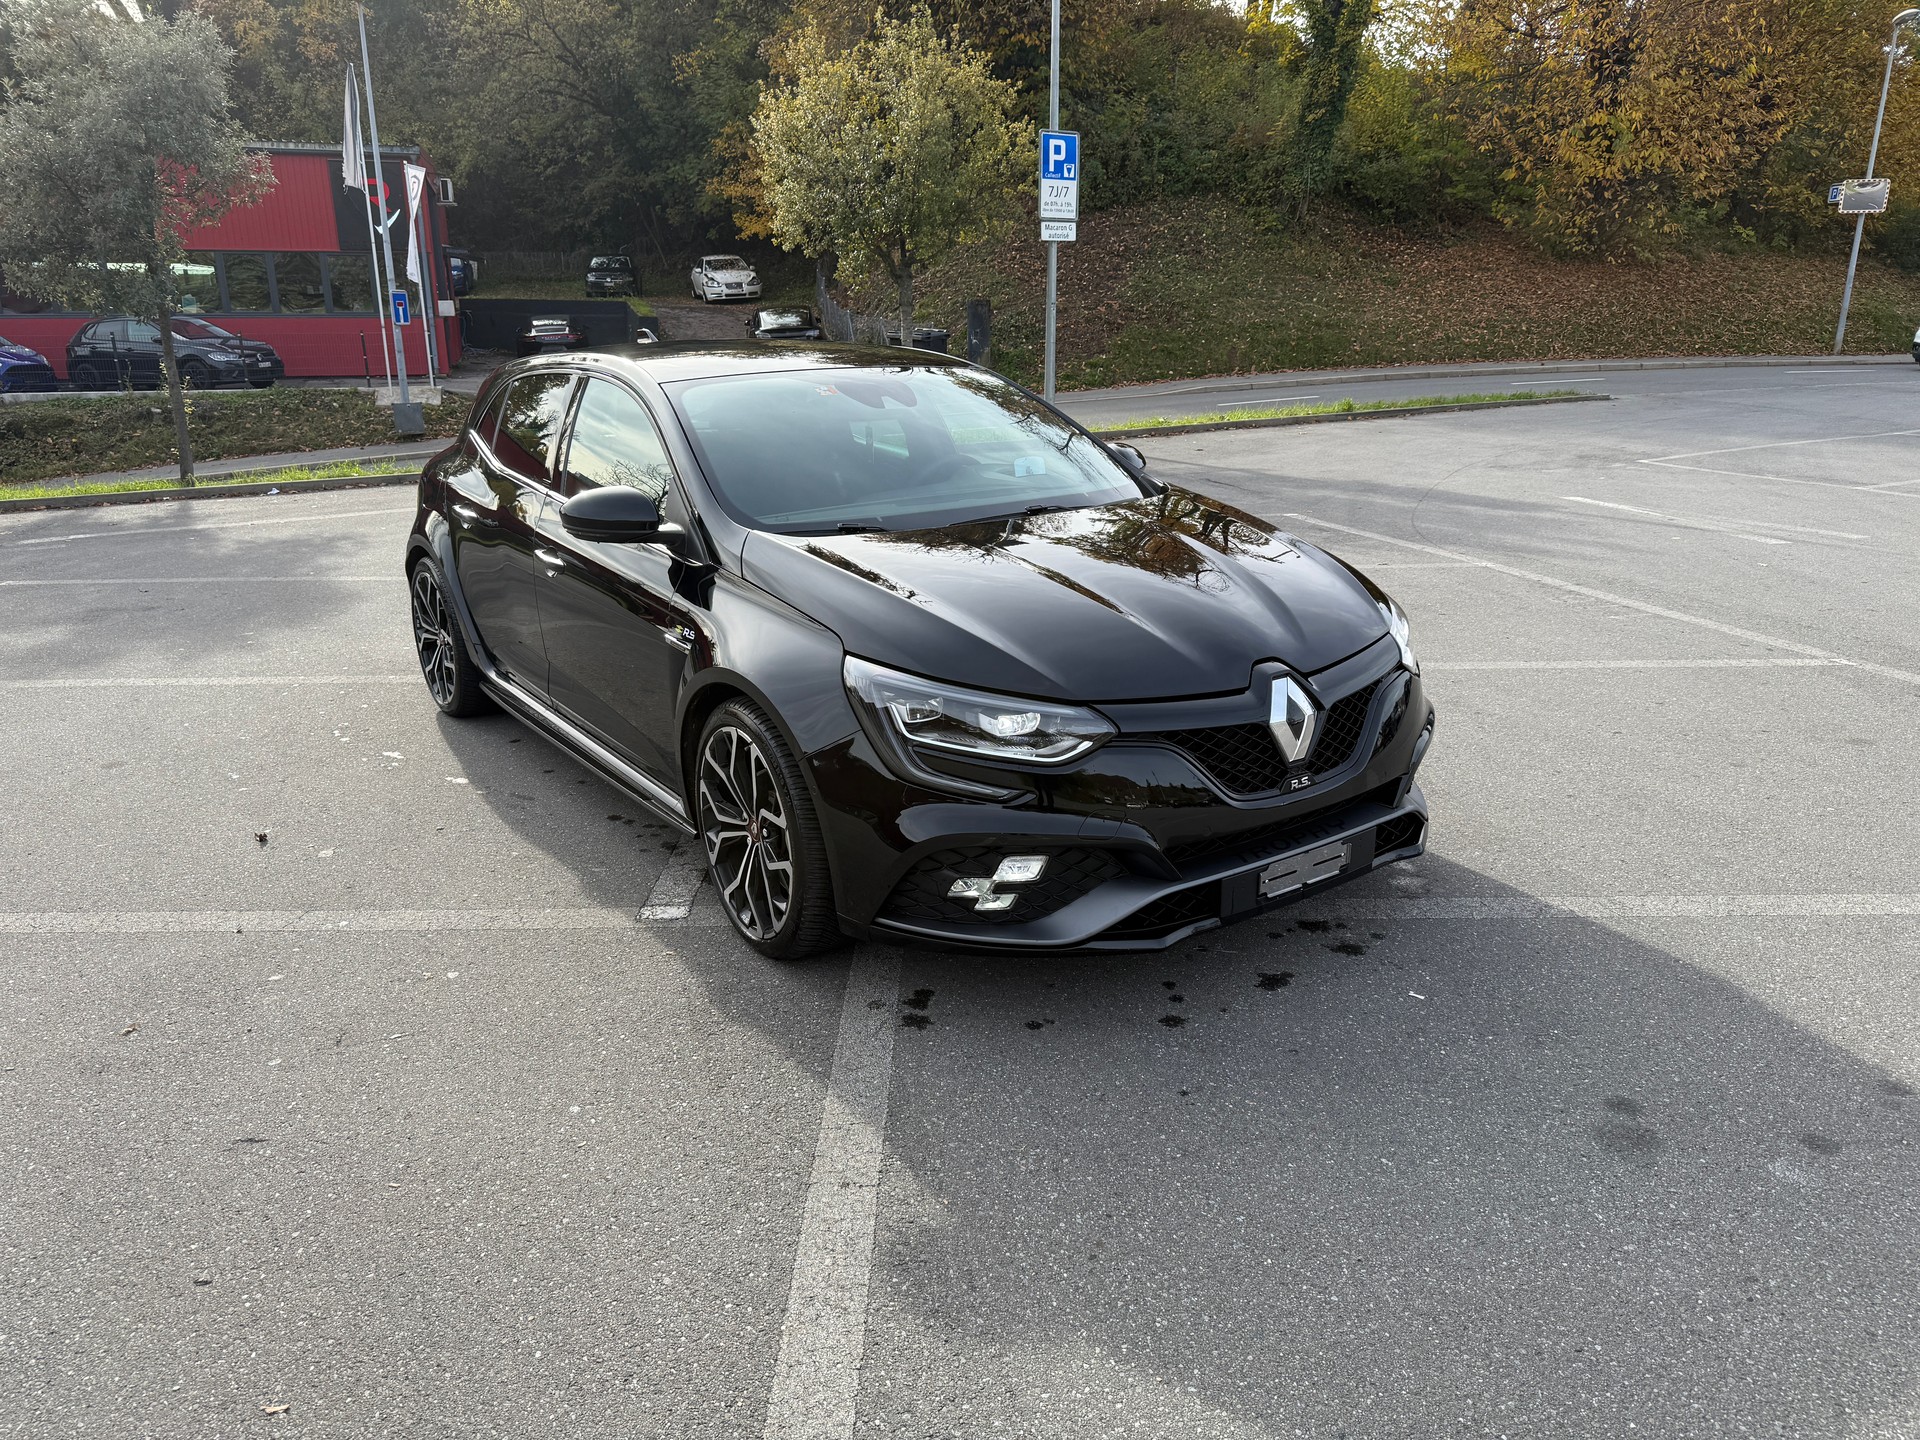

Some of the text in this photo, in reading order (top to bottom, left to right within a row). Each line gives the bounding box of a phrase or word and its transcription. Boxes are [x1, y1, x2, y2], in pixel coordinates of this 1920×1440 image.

[1049, 138, 1066, 172] P
[1048, 185, 1070, 198] 7J/7
[1045, 223, 1067, 231] Macaron
[1048, 231, 1069, 240] autorisé
[1233, 817, 1346, 863] TROPHY
